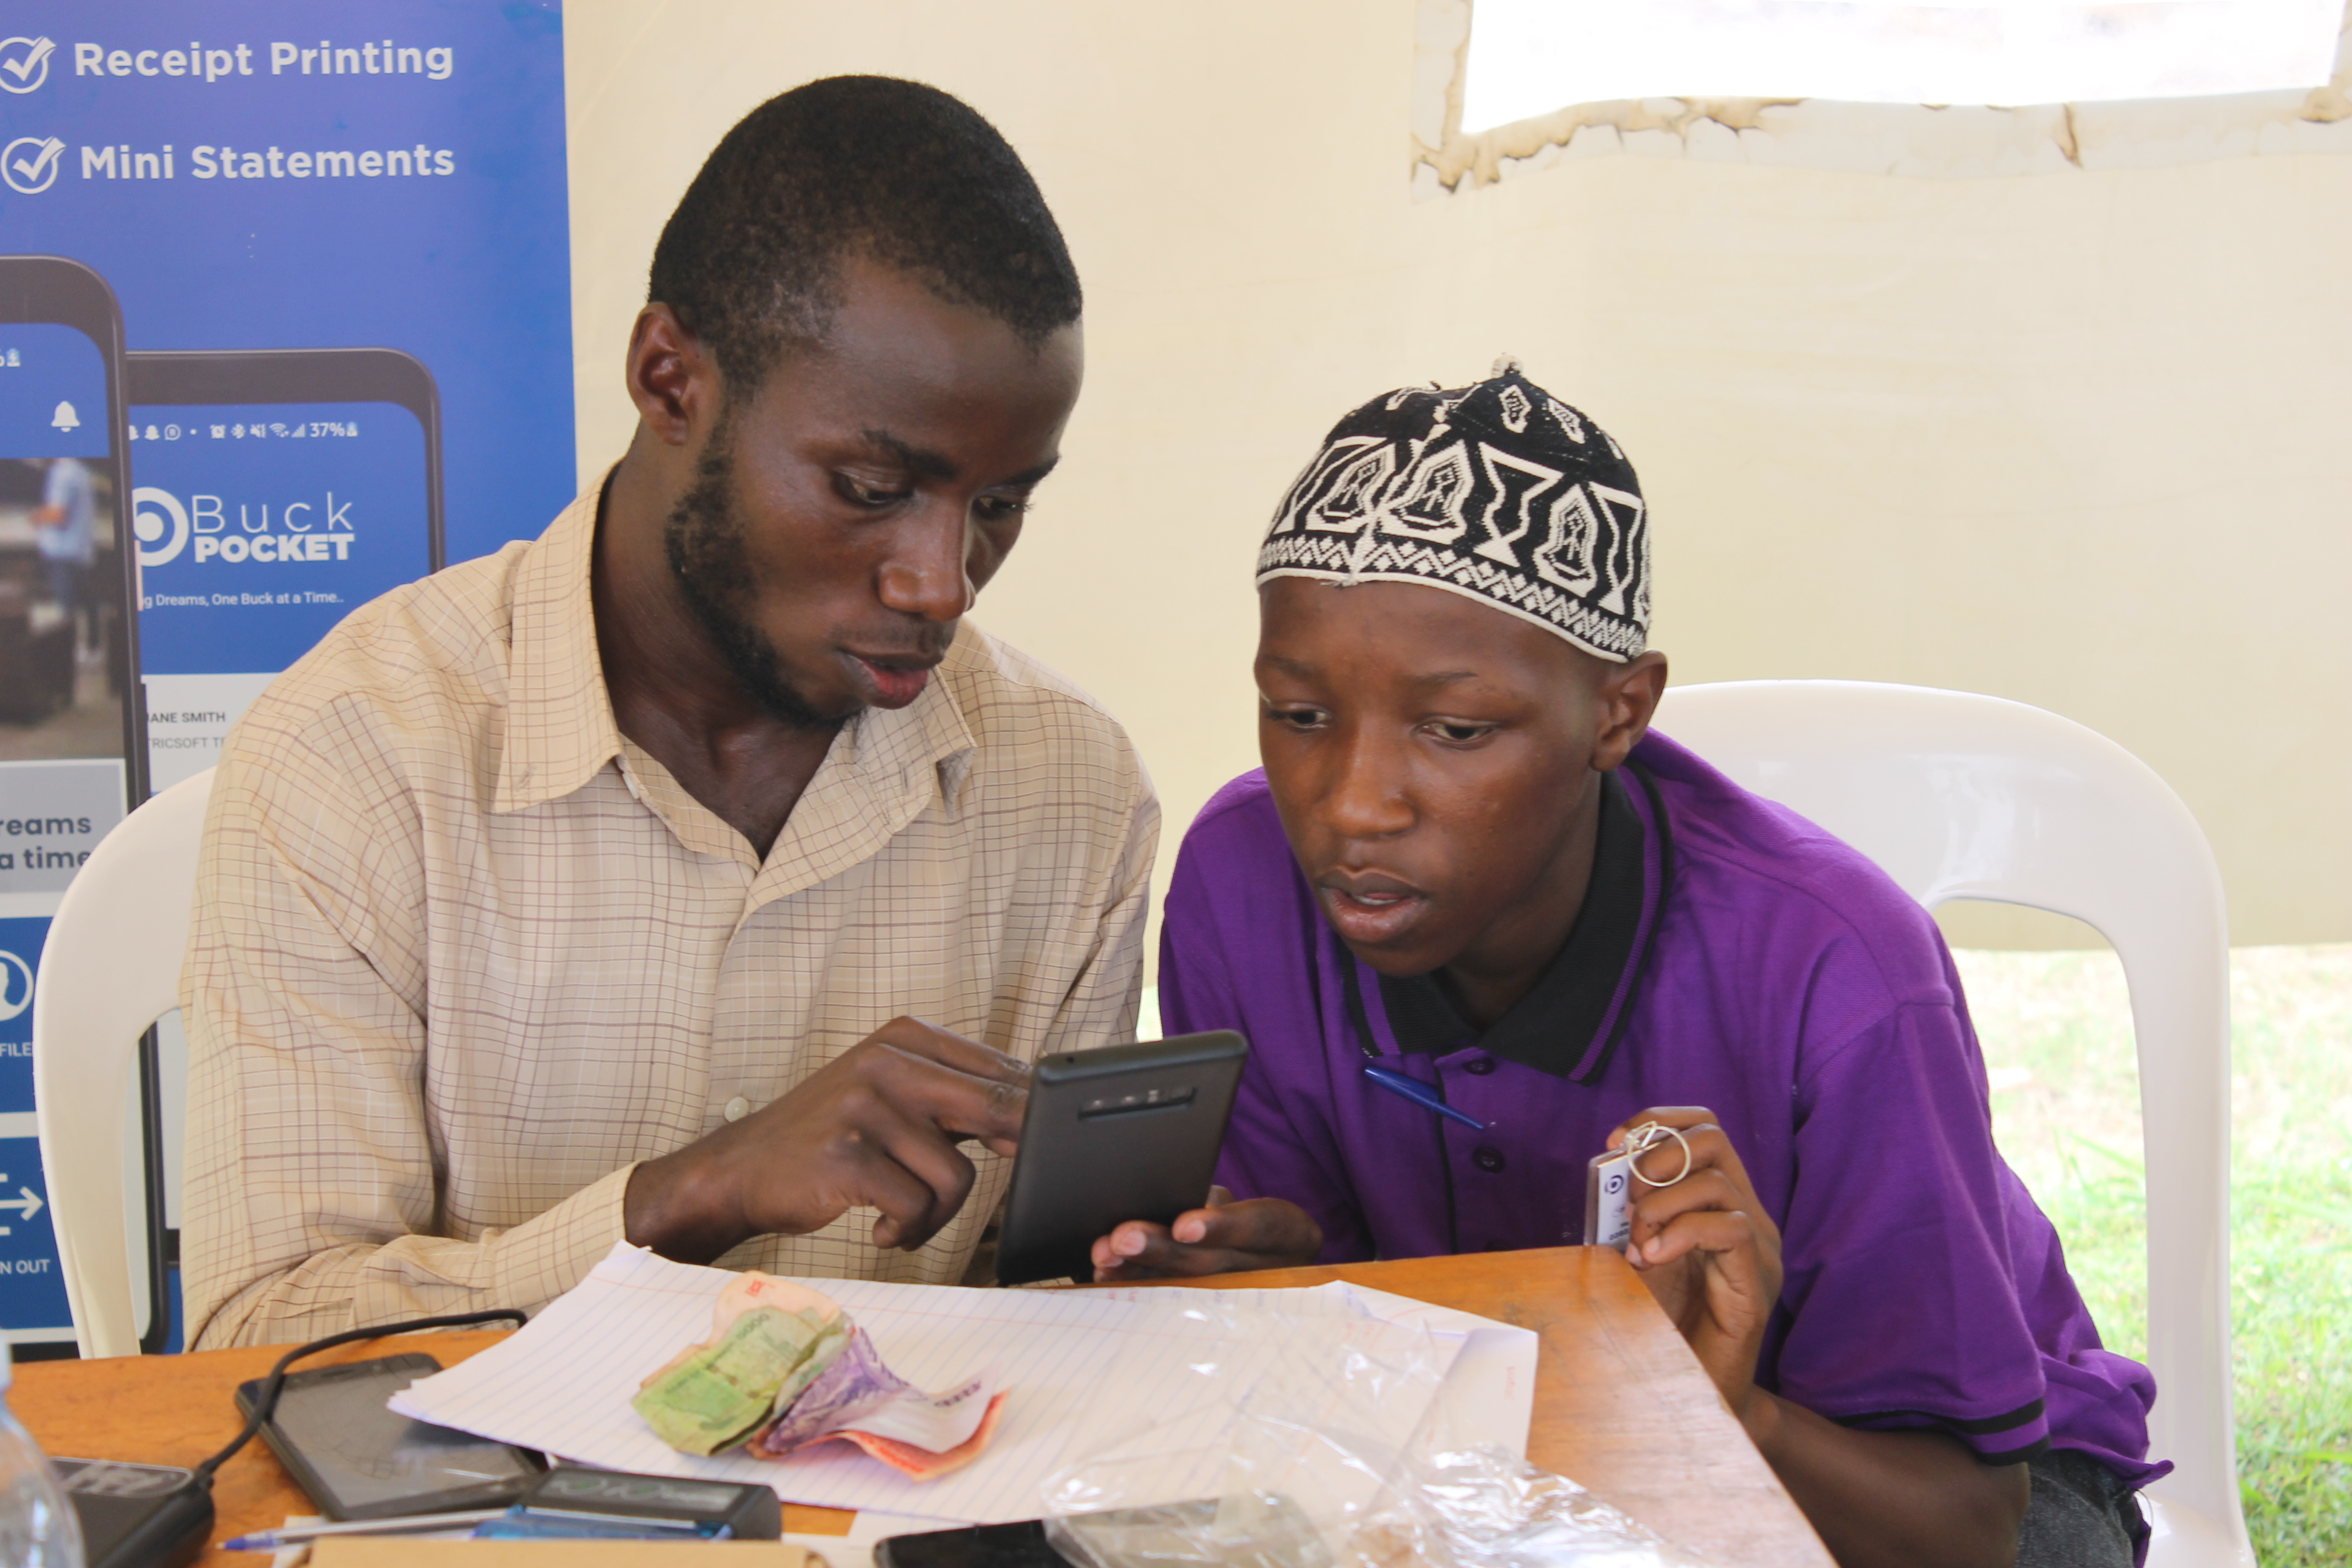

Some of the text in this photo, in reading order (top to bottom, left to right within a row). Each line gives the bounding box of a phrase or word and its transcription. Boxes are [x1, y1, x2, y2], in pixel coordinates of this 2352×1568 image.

[75, 40, 453, 83] Receipt Printing
[81, 144, 454, 179] Mini Statements
[309, 422, 345, 437] 37%
[192, 491, 353, 533] Buck
[194, 533, 355, 563] POCKET
[155, 594, 209, 607] Dreams,
[211, 594, 238, 606] One
[241, 592, 274, 605] Buck
[276, 593, 290, 604] at
[292, 594, 301, 603] a
[148, 712, 225, 723] ANE SMITH
[16, 1259, 51, 1274] OUT
